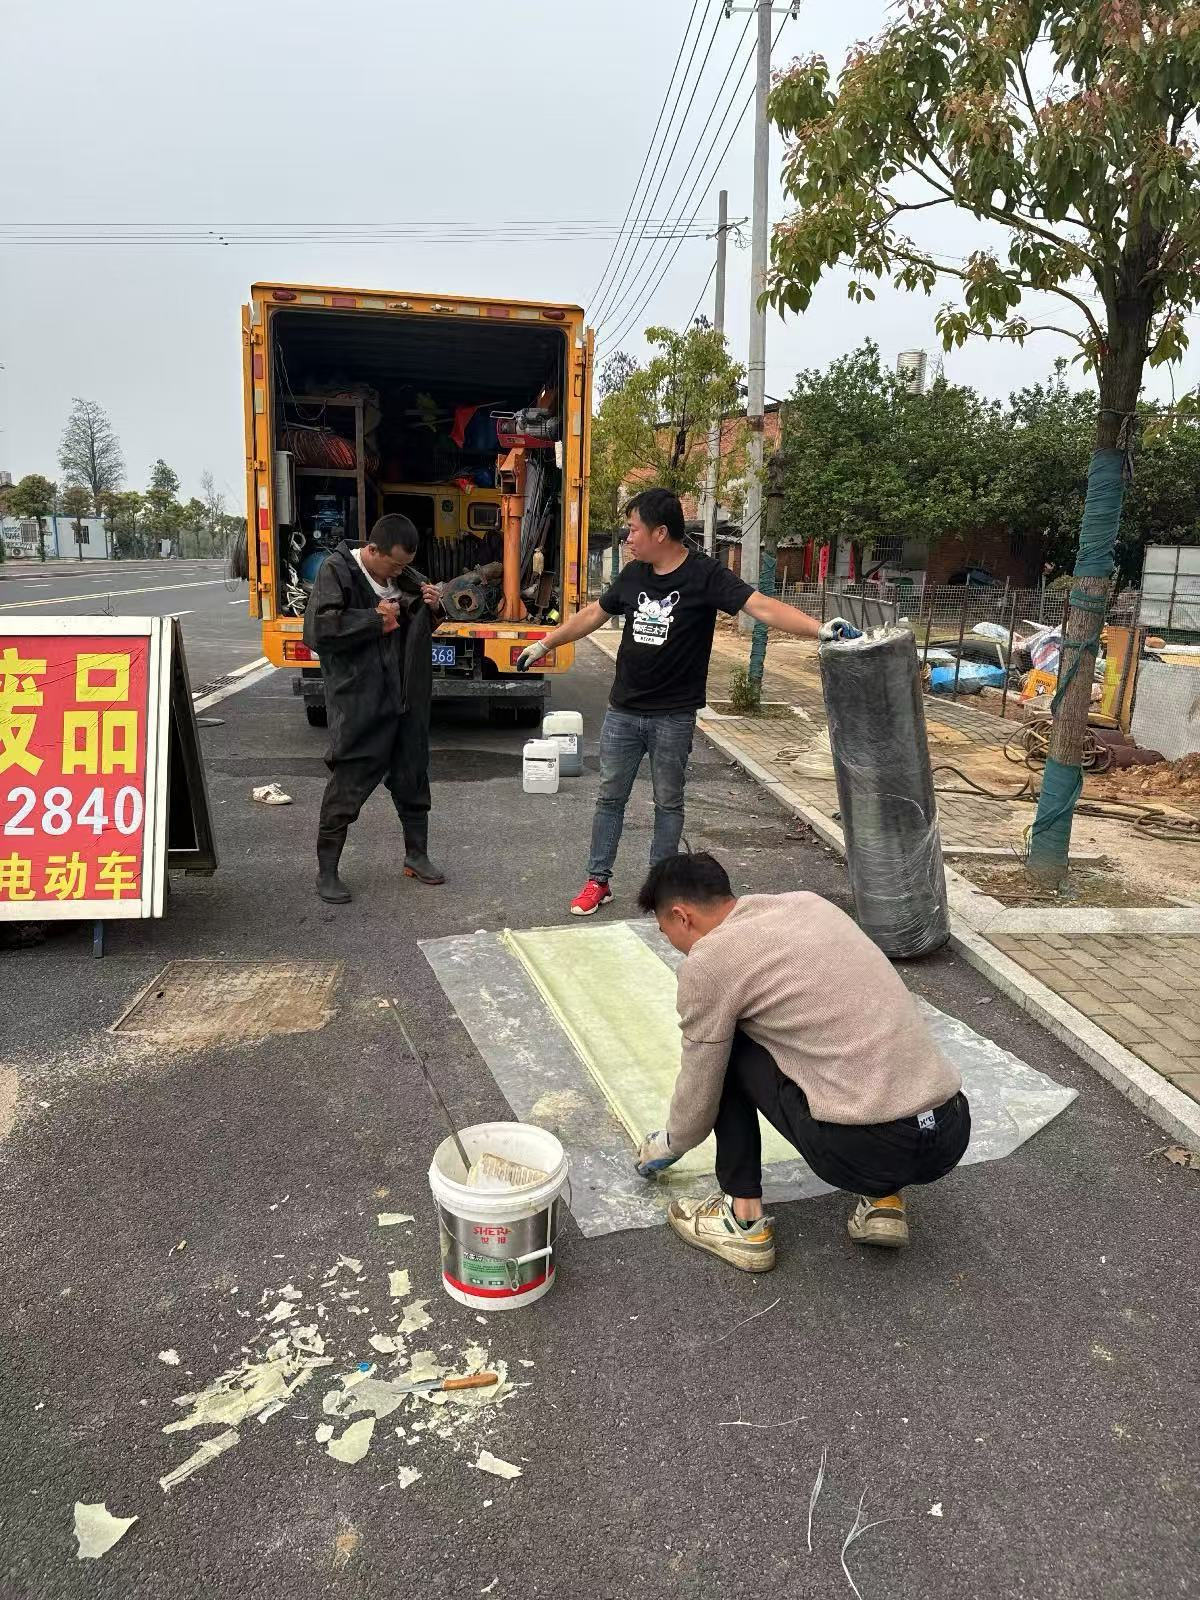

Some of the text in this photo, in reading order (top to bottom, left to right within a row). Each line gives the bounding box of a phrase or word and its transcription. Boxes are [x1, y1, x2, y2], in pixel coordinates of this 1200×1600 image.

[4, 785, 144, 836] 2840
[0, 851, 138, 901] 电动车
